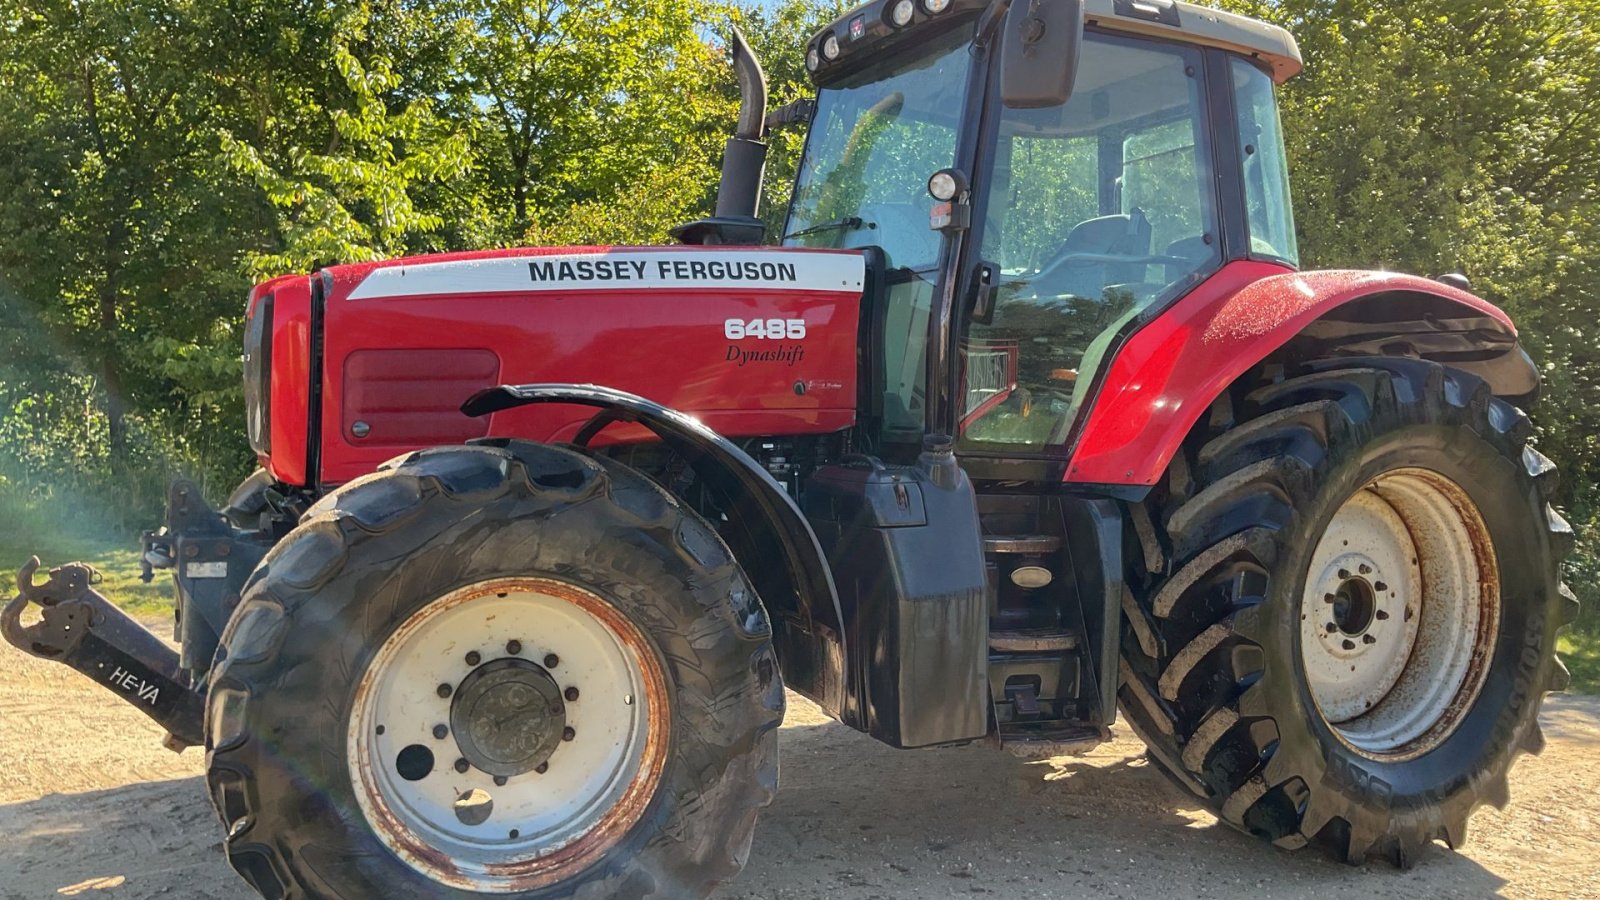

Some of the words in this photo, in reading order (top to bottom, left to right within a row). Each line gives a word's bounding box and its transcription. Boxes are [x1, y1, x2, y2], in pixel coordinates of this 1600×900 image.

[528, 261, 647, 281] MASSEY
[657, 261, 797, 281] FERGUSON
[724, 318, 806, 340] 6485
[725, 344, 805, 367] Dynashift
[109, 666, 160, 705] HE-VA
